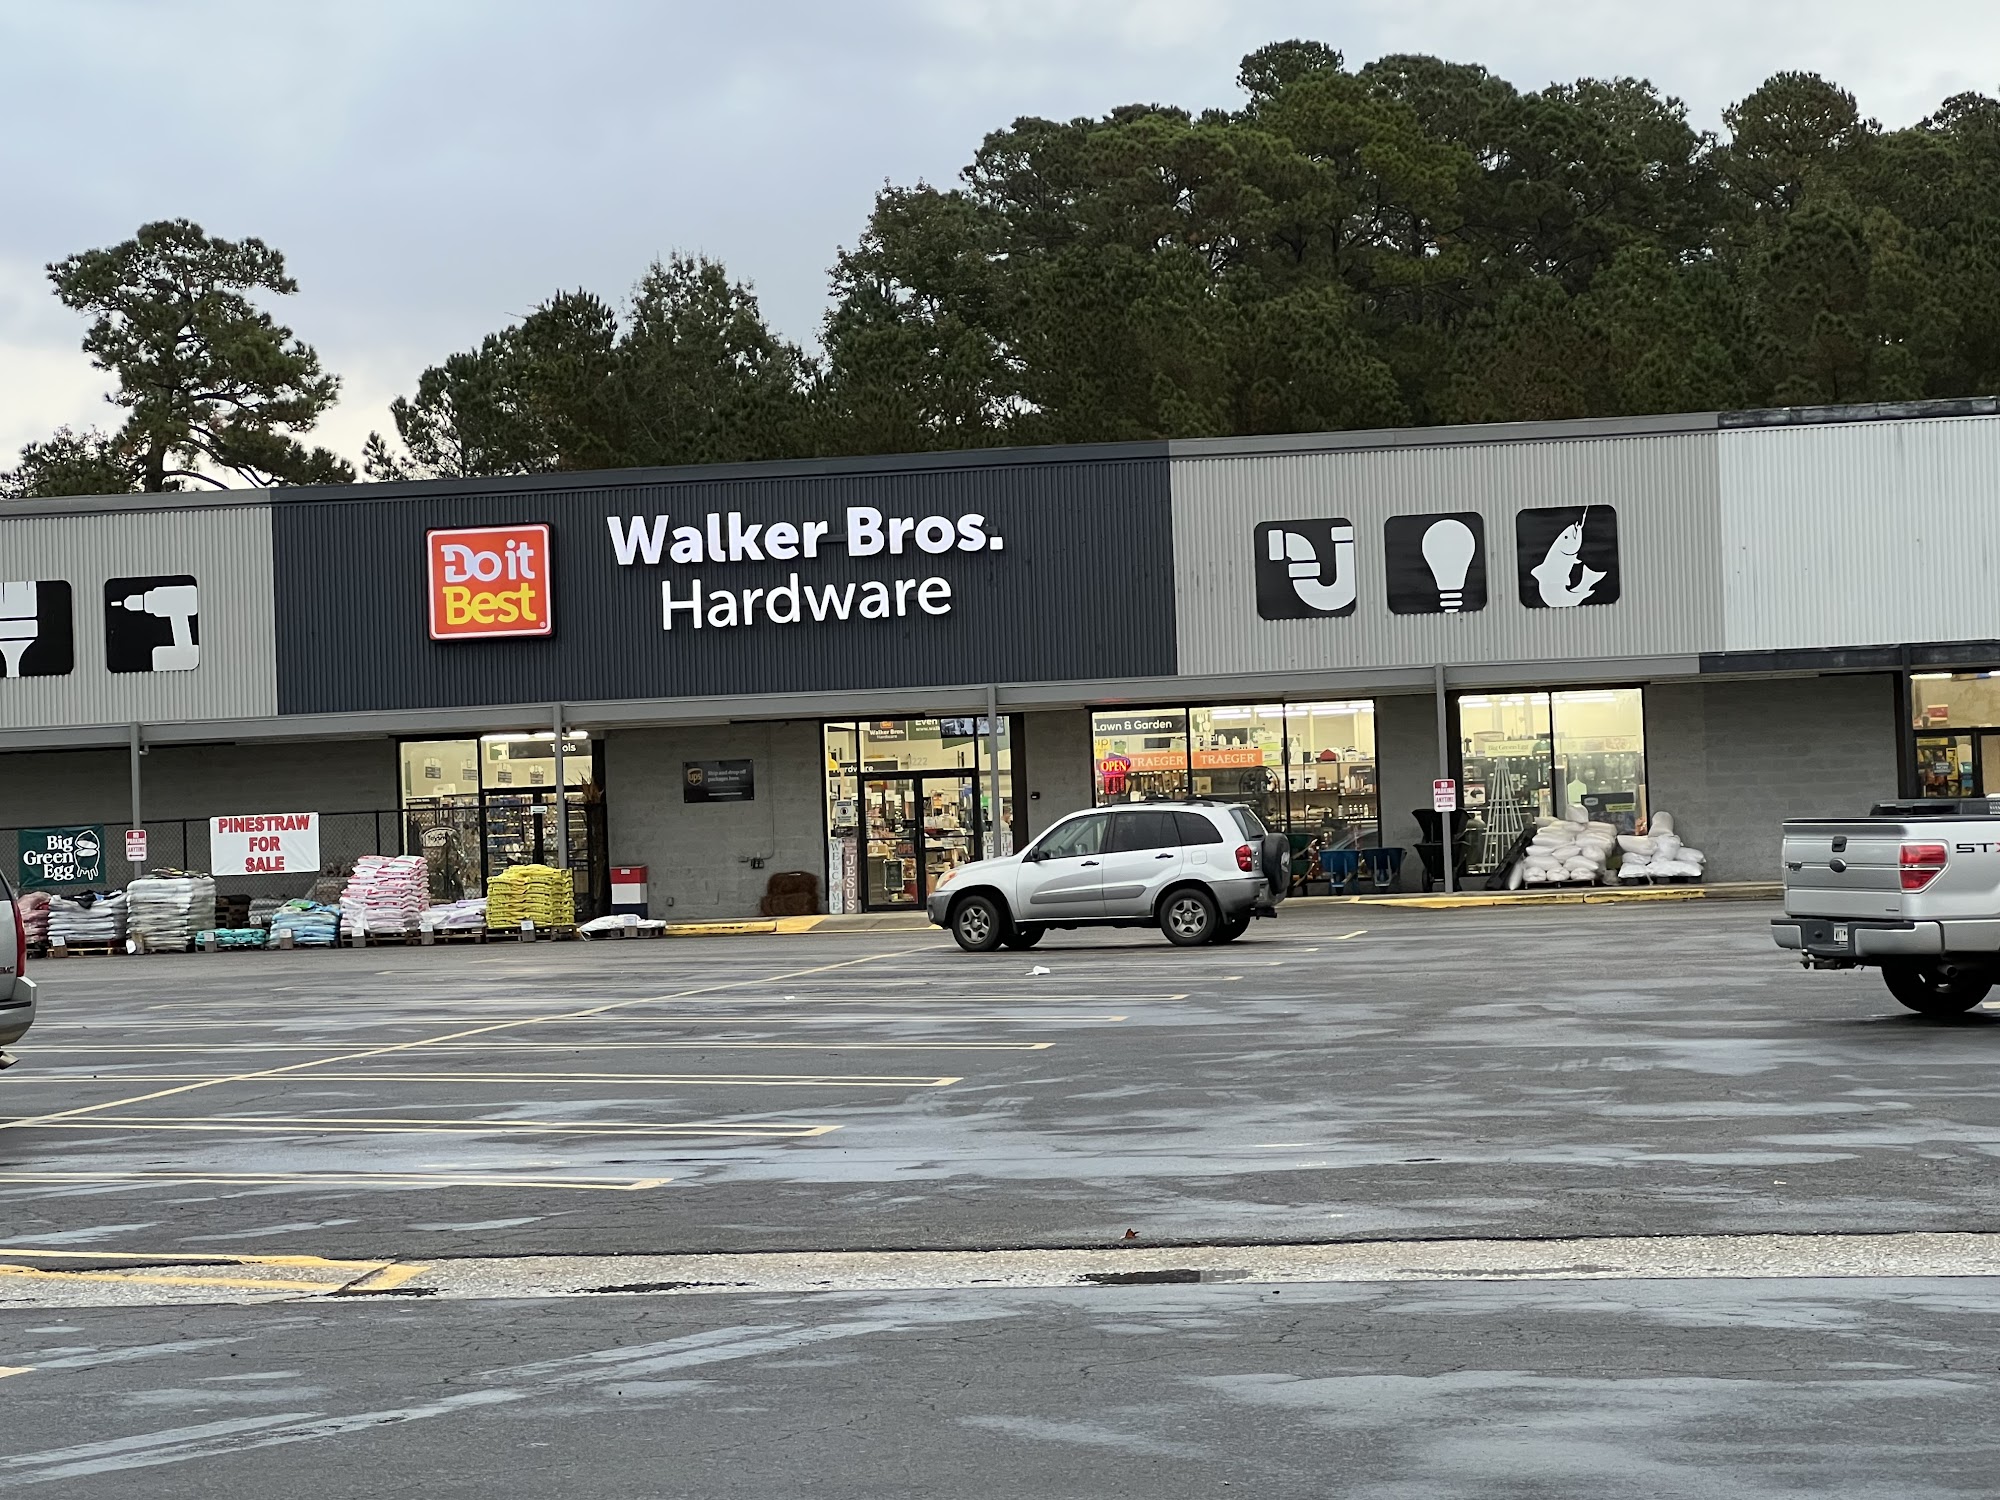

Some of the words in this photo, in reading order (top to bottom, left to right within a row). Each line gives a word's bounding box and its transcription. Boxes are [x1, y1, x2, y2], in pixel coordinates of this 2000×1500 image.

[607, 512, 829, 566] Walker
[846, 506, 1004, 557] Bros.
[441, 544, 502, 582] Do
[504, 539, 535, 580] it
[442, 582, 537, 624] Best
[661, 573, 952, 631] Hardware
[1095, 722, 1122, 732] Lawn
[1124, 720, 1132, 730] &
[1133, 720, 1173, 730] Garden
[550, 742, 576, 752] Tols
[1100, 760, 1127, 772] OPEN
[1131, 756, 1185, 767] TRAEGER
[1200, 753, 1255, 764] TRAEGER
[218, 815, 310, 833] PINESTRAW
[47, 835, 73, 852] Big
[249, 836, 281, 852] FOR
[23, 850, 74, 866] Green
[245, 856, 285, 873] SALE
[44, 863, 74, 881] Egg
[845, 854, 856, 911] JESUS
